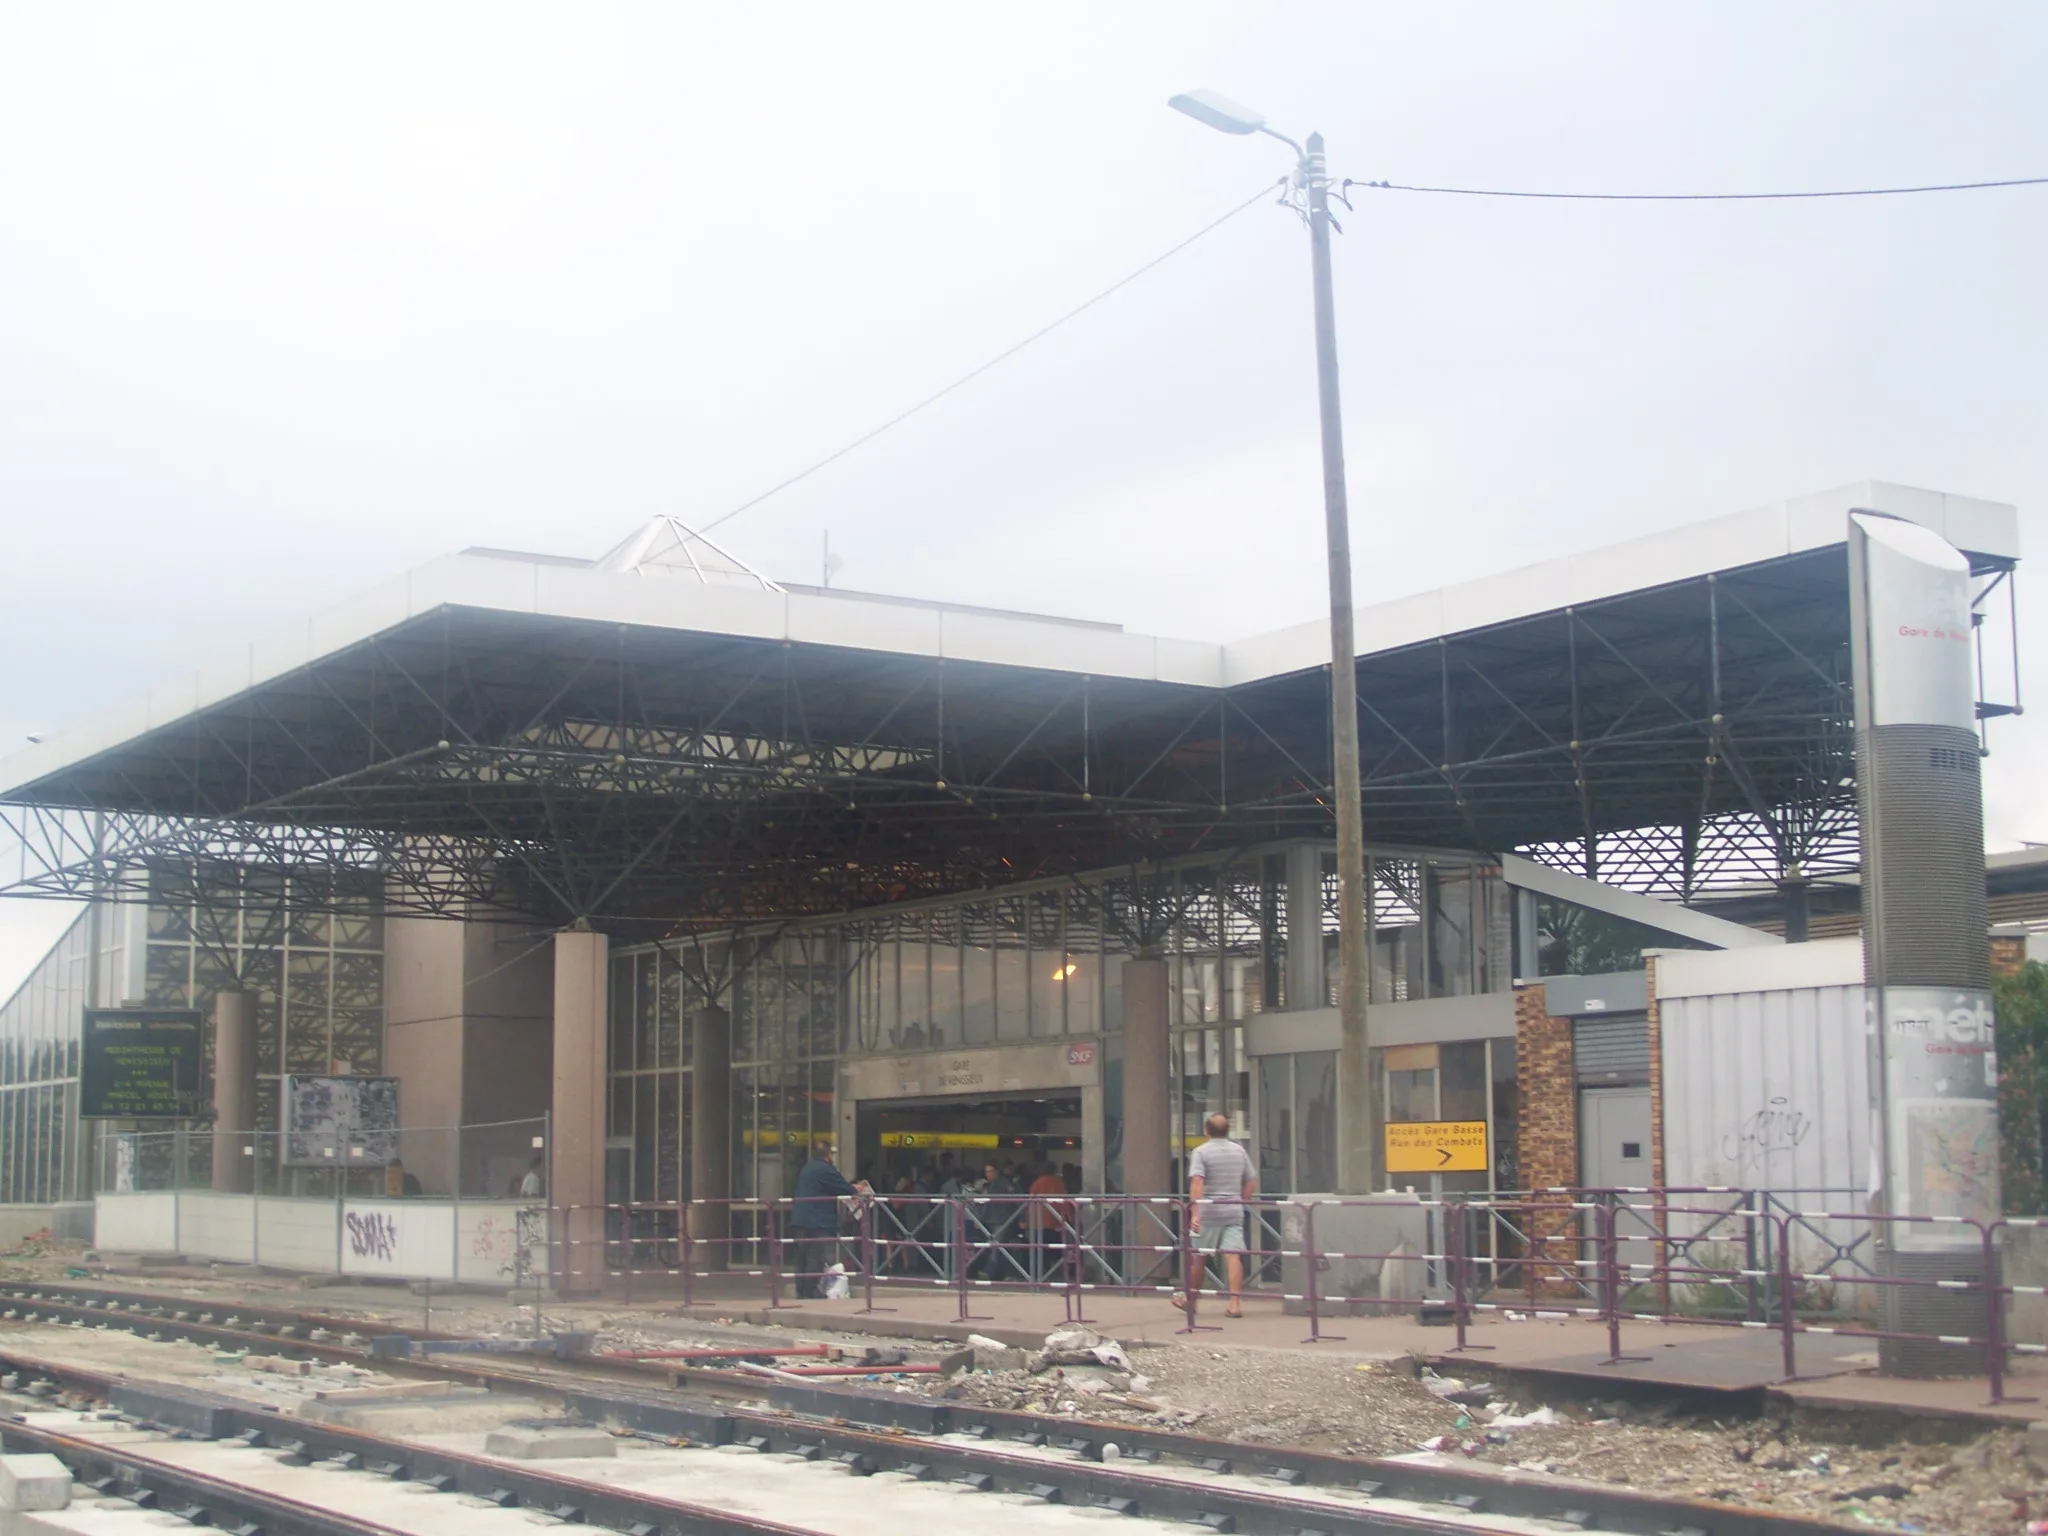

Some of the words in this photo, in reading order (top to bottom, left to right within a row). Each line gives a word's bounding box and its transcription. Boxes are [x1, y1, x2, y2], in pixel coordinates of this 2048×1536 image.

[1898, 625, 1929, 638] Gare
[1891, 994, 1993, 1043] mét
[1069, 1050, 1093, 1063] SNCF
[952, 1060, 970, 1071] GARE
[1424, 1125, 1449, 1135] Gare
[1453, 1124, 1485, 1134] Basse
[1390, 1138, 1409, 1147] Rue
[1413, 1138, 1433, 1147] des
[1436, 1136, 1484, 1146] Combats
